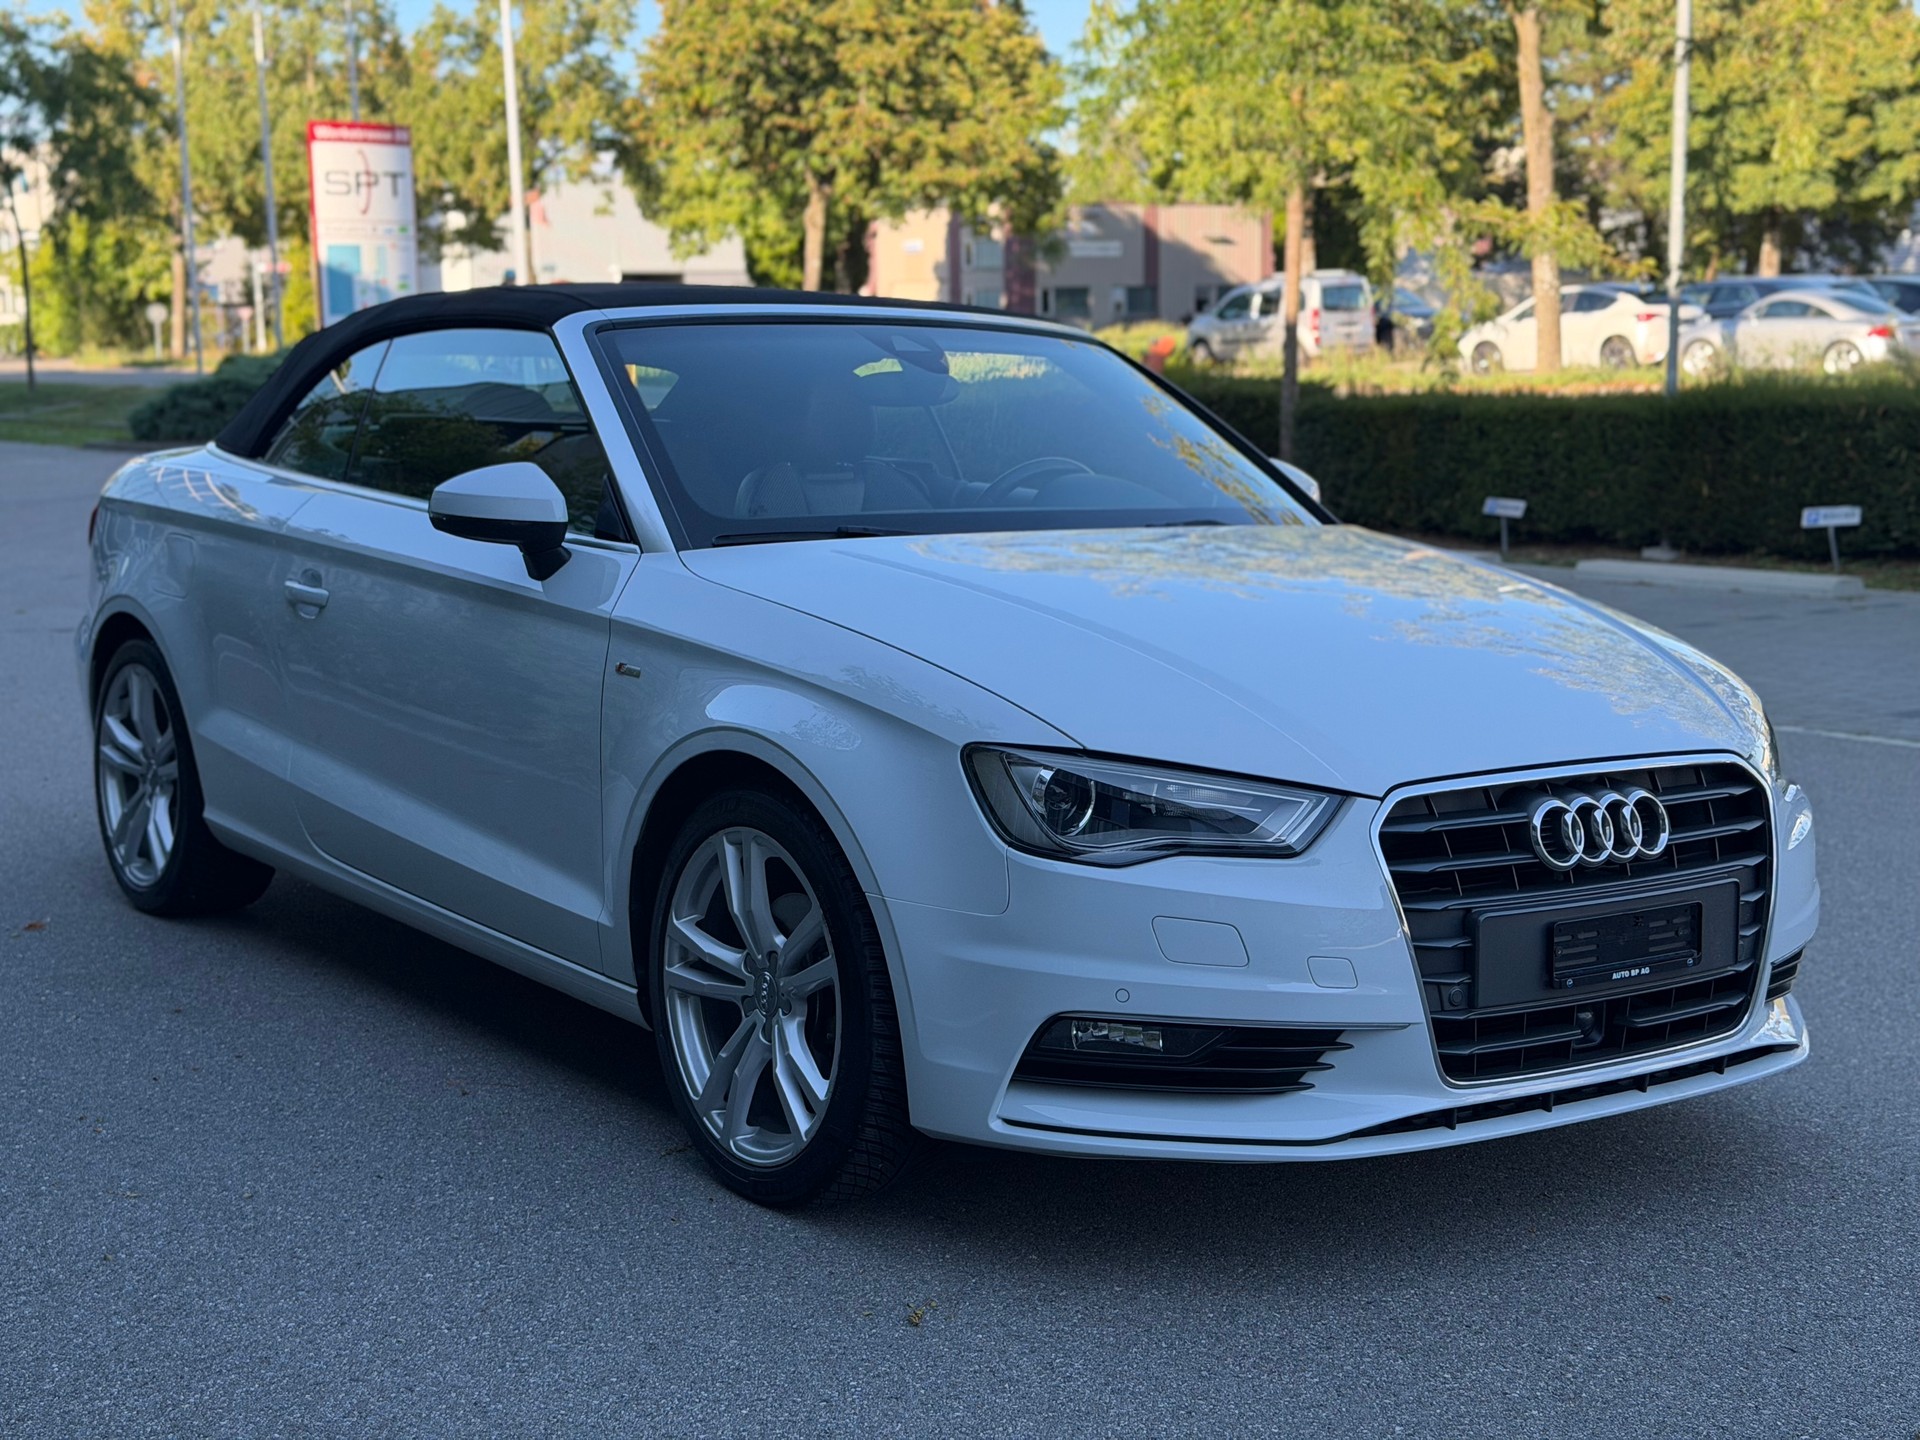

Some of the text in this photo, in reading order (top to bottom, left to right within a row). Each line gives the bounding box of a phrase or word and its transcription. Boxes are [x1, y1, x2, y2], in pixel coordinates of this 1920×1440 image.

[325, 170, 406, 198] SPT
[1612, 966, 1650, 980] AUTO BP AG
